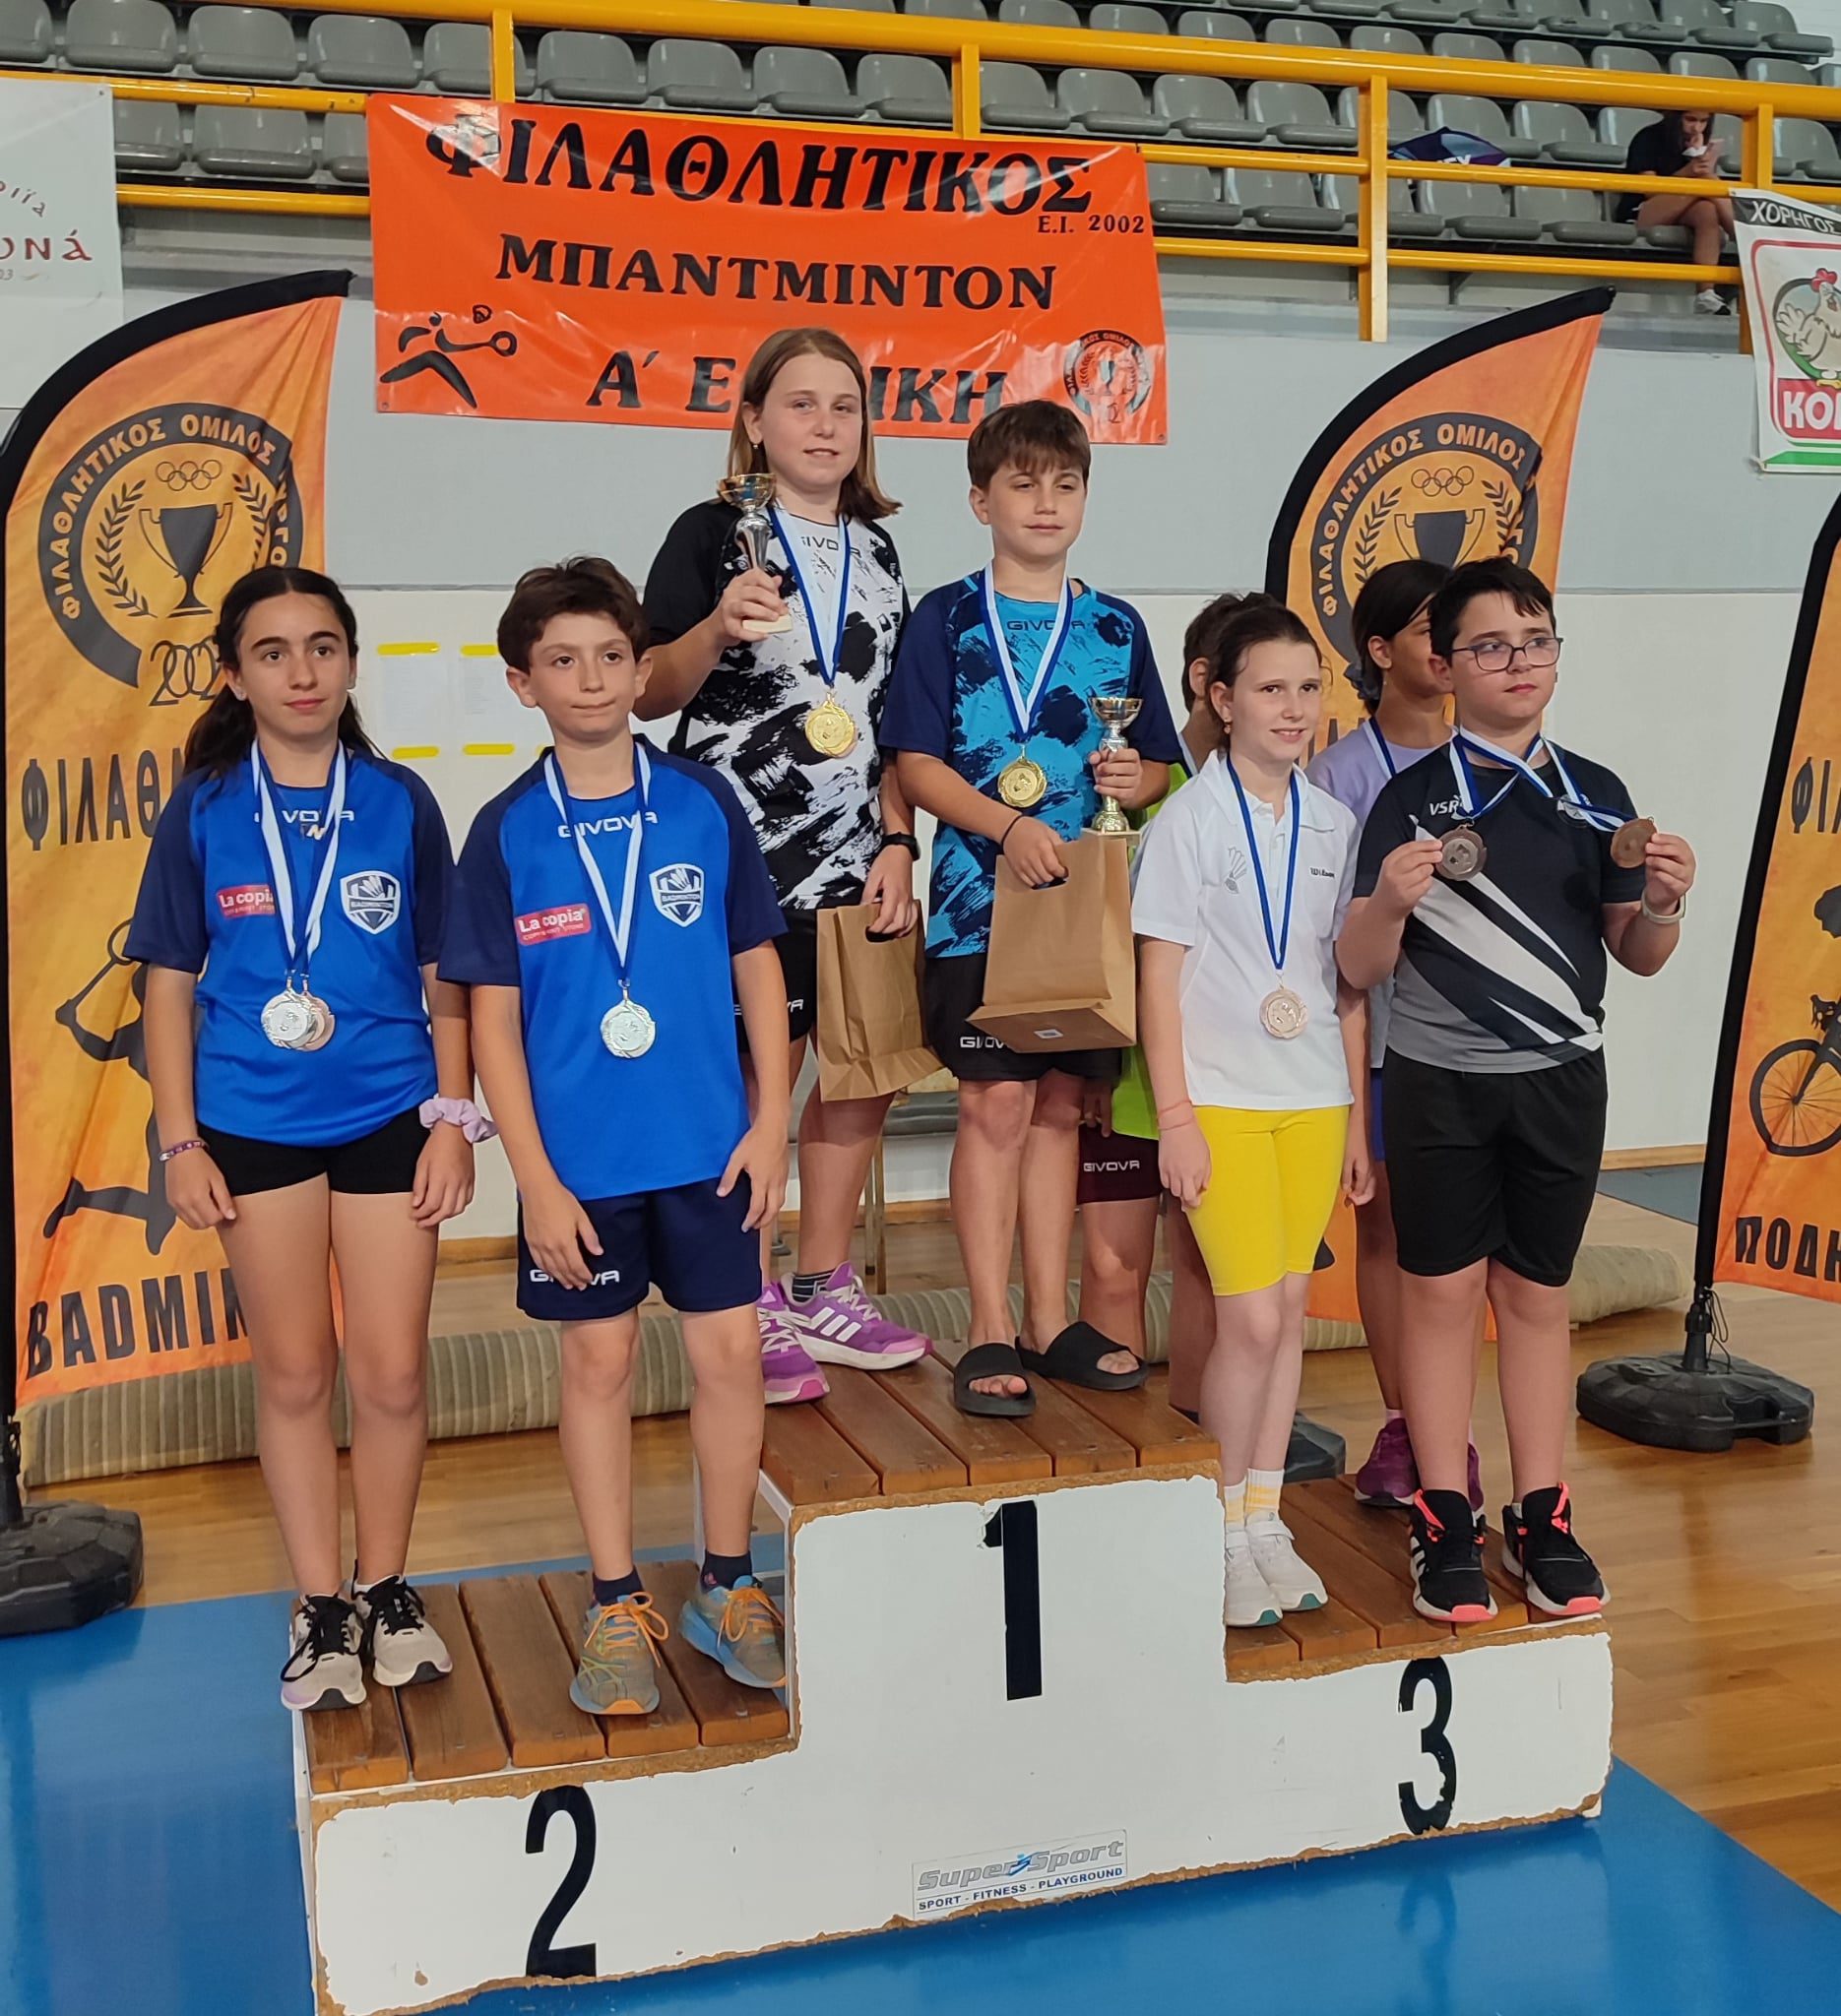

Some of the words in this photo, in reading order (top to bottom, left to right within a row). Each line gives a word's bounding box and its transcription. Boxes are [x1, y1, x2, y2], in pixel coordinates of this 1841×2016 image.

[426, 114, 1092, 215] ΦΙΛΑΘΛΗΤΙΚΟΣ
[1089, 215, 1144, 233] 2002
[494, 233, 1056, 310] ΜΠΑΝΤΜΙΝΤΟΝ
[685, 356, 1007, 424] ΕΙΚΗ
[1783, 390, 1841, 431] ΚΟ
[49, 417, 166, 620] ΦΙΛΑΘΛΗΤΙΚΟΣ
[180, 414, 277, 466] ΟΜΙΛΟΣ
[1319, 429, 1425, 616] ΦΙΛΑΘΛΗΤΙΚΟΣ
[1437, 423, 1526, 471] ΟΜΙΛΟΣ
[1006, 619, 1085, 631] GIVOA
[220, 894, 234, 908] La
[518, 919, 541, 933] La
[1083, 1160, 1140, 1172] GIVOVA
[984, 1501, 1043, 1701] 1
[1398, 1658, 1454, 1835] 3
[525, 1785, 599, 1979] 2
[920, 1895, 961, 1911] SPORT
[973, 1884, 1027, 1901] FITNESS
[1039, 1867, 1123, 1889] PLAYGROUND
